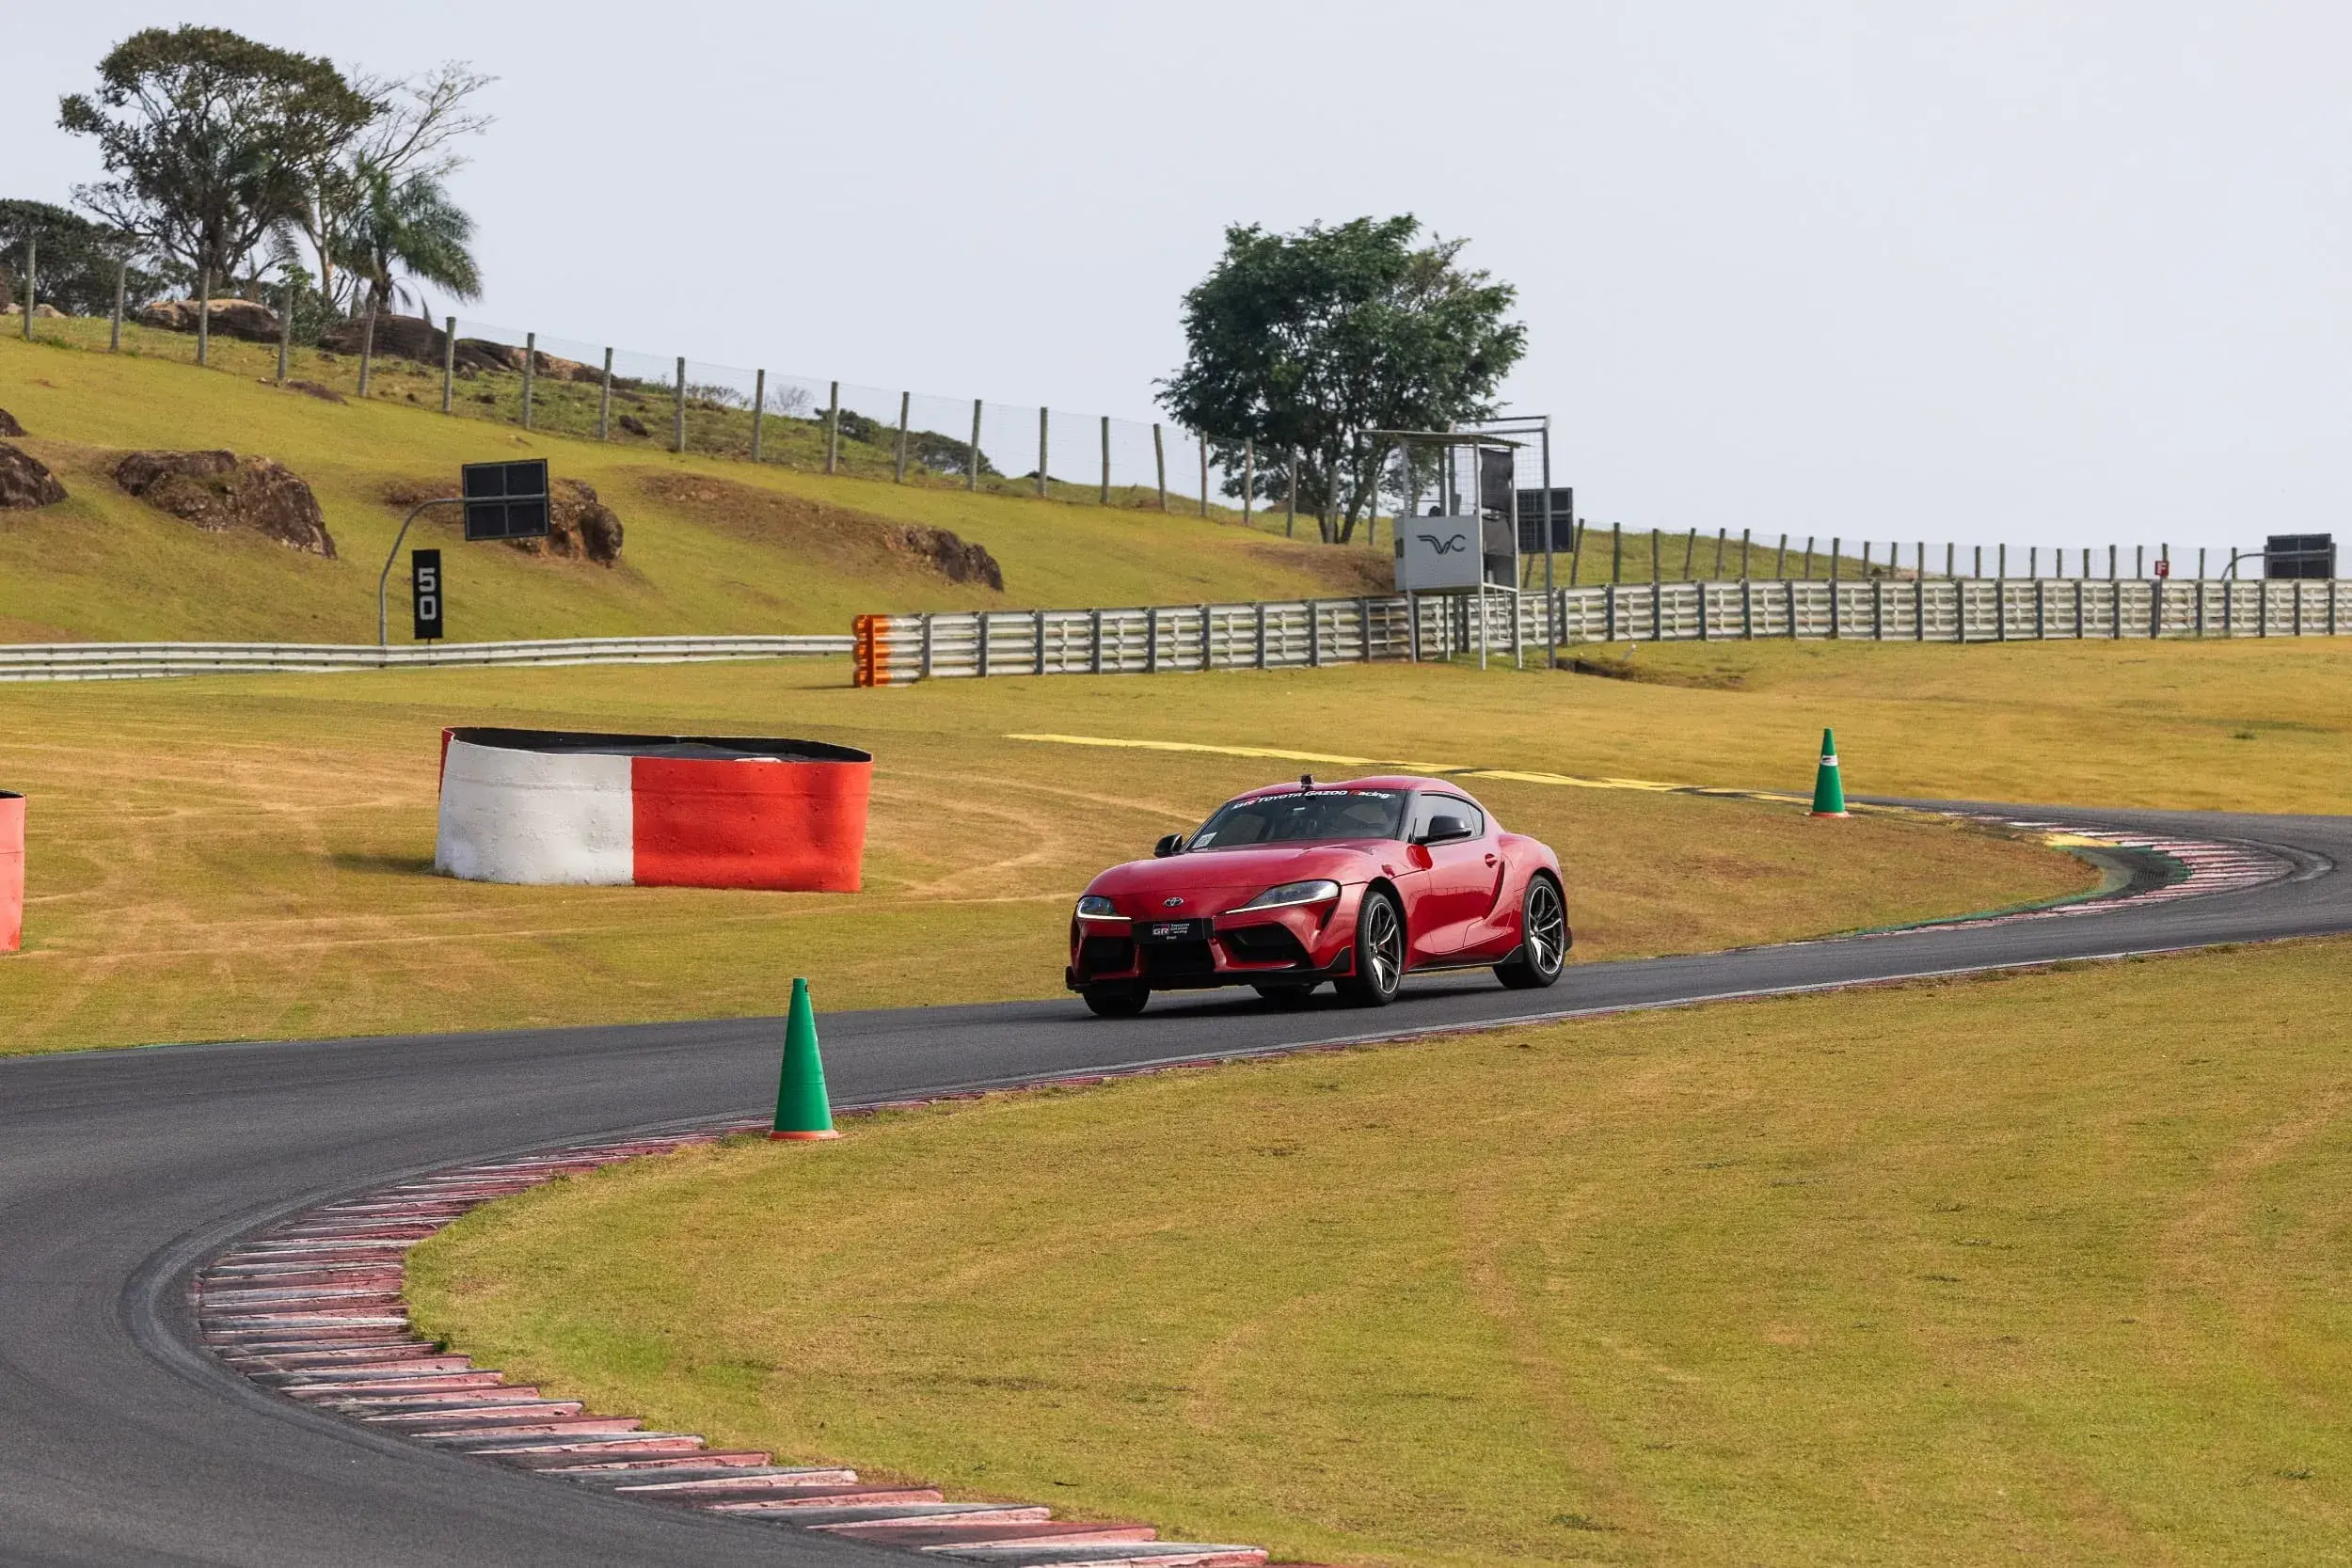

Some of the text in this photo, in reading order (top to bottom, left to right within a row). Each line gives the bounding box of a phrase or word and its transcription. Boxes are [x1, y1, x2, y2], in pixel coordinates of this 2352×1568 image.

[2157, 562, 2166, 574] F
[418, 567, 437, 621] 50
[1258, 792, 1302, 802] TOYOTA
[1349, 789, 1390, 799] Racing
